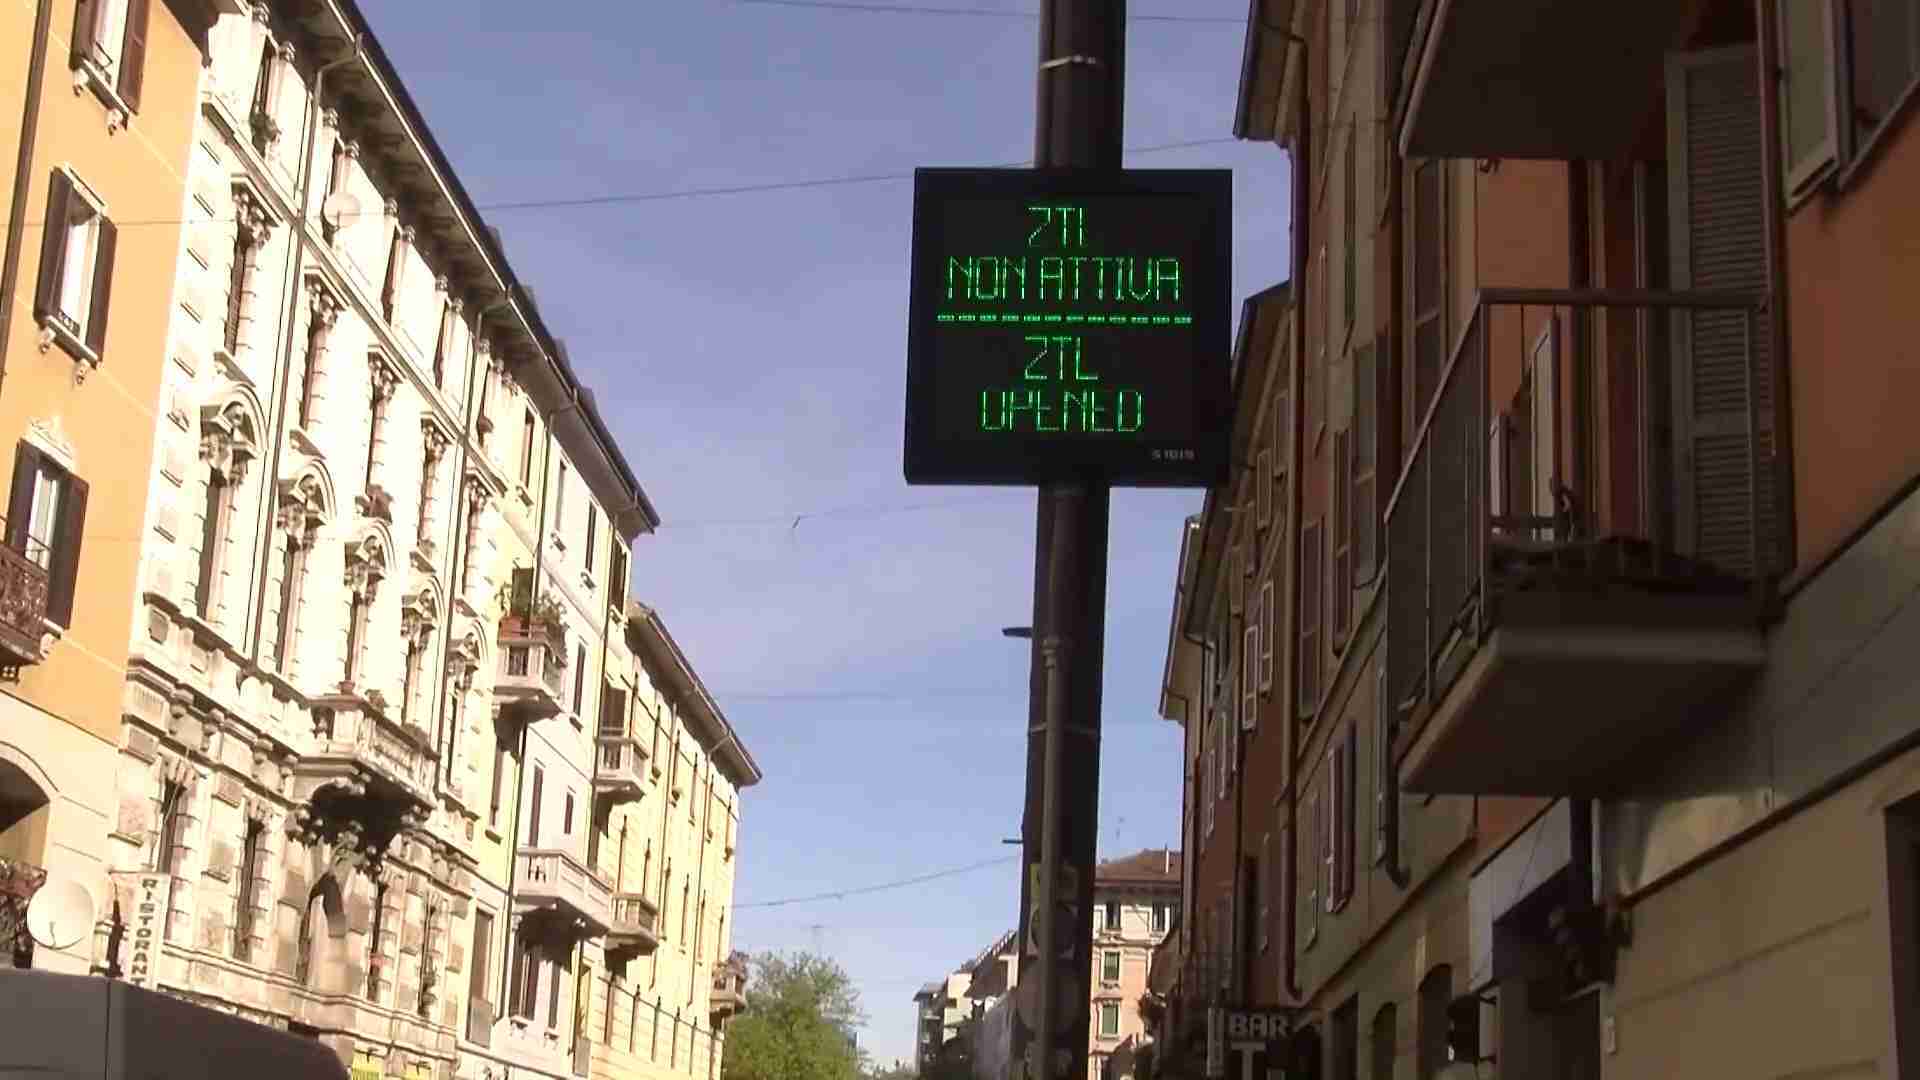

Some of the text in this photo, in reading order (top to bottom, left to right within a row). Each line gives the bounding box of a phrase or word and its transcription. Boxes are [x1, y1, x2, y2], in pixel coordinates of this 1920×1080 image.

[947, 256, 1181, 301] NON ATTIVA
[1024, 336, 1099, 380] ZTL
[131, 878, 158, 986] RISTORANT
[1229, 1012, 1289, 1038] BAR
